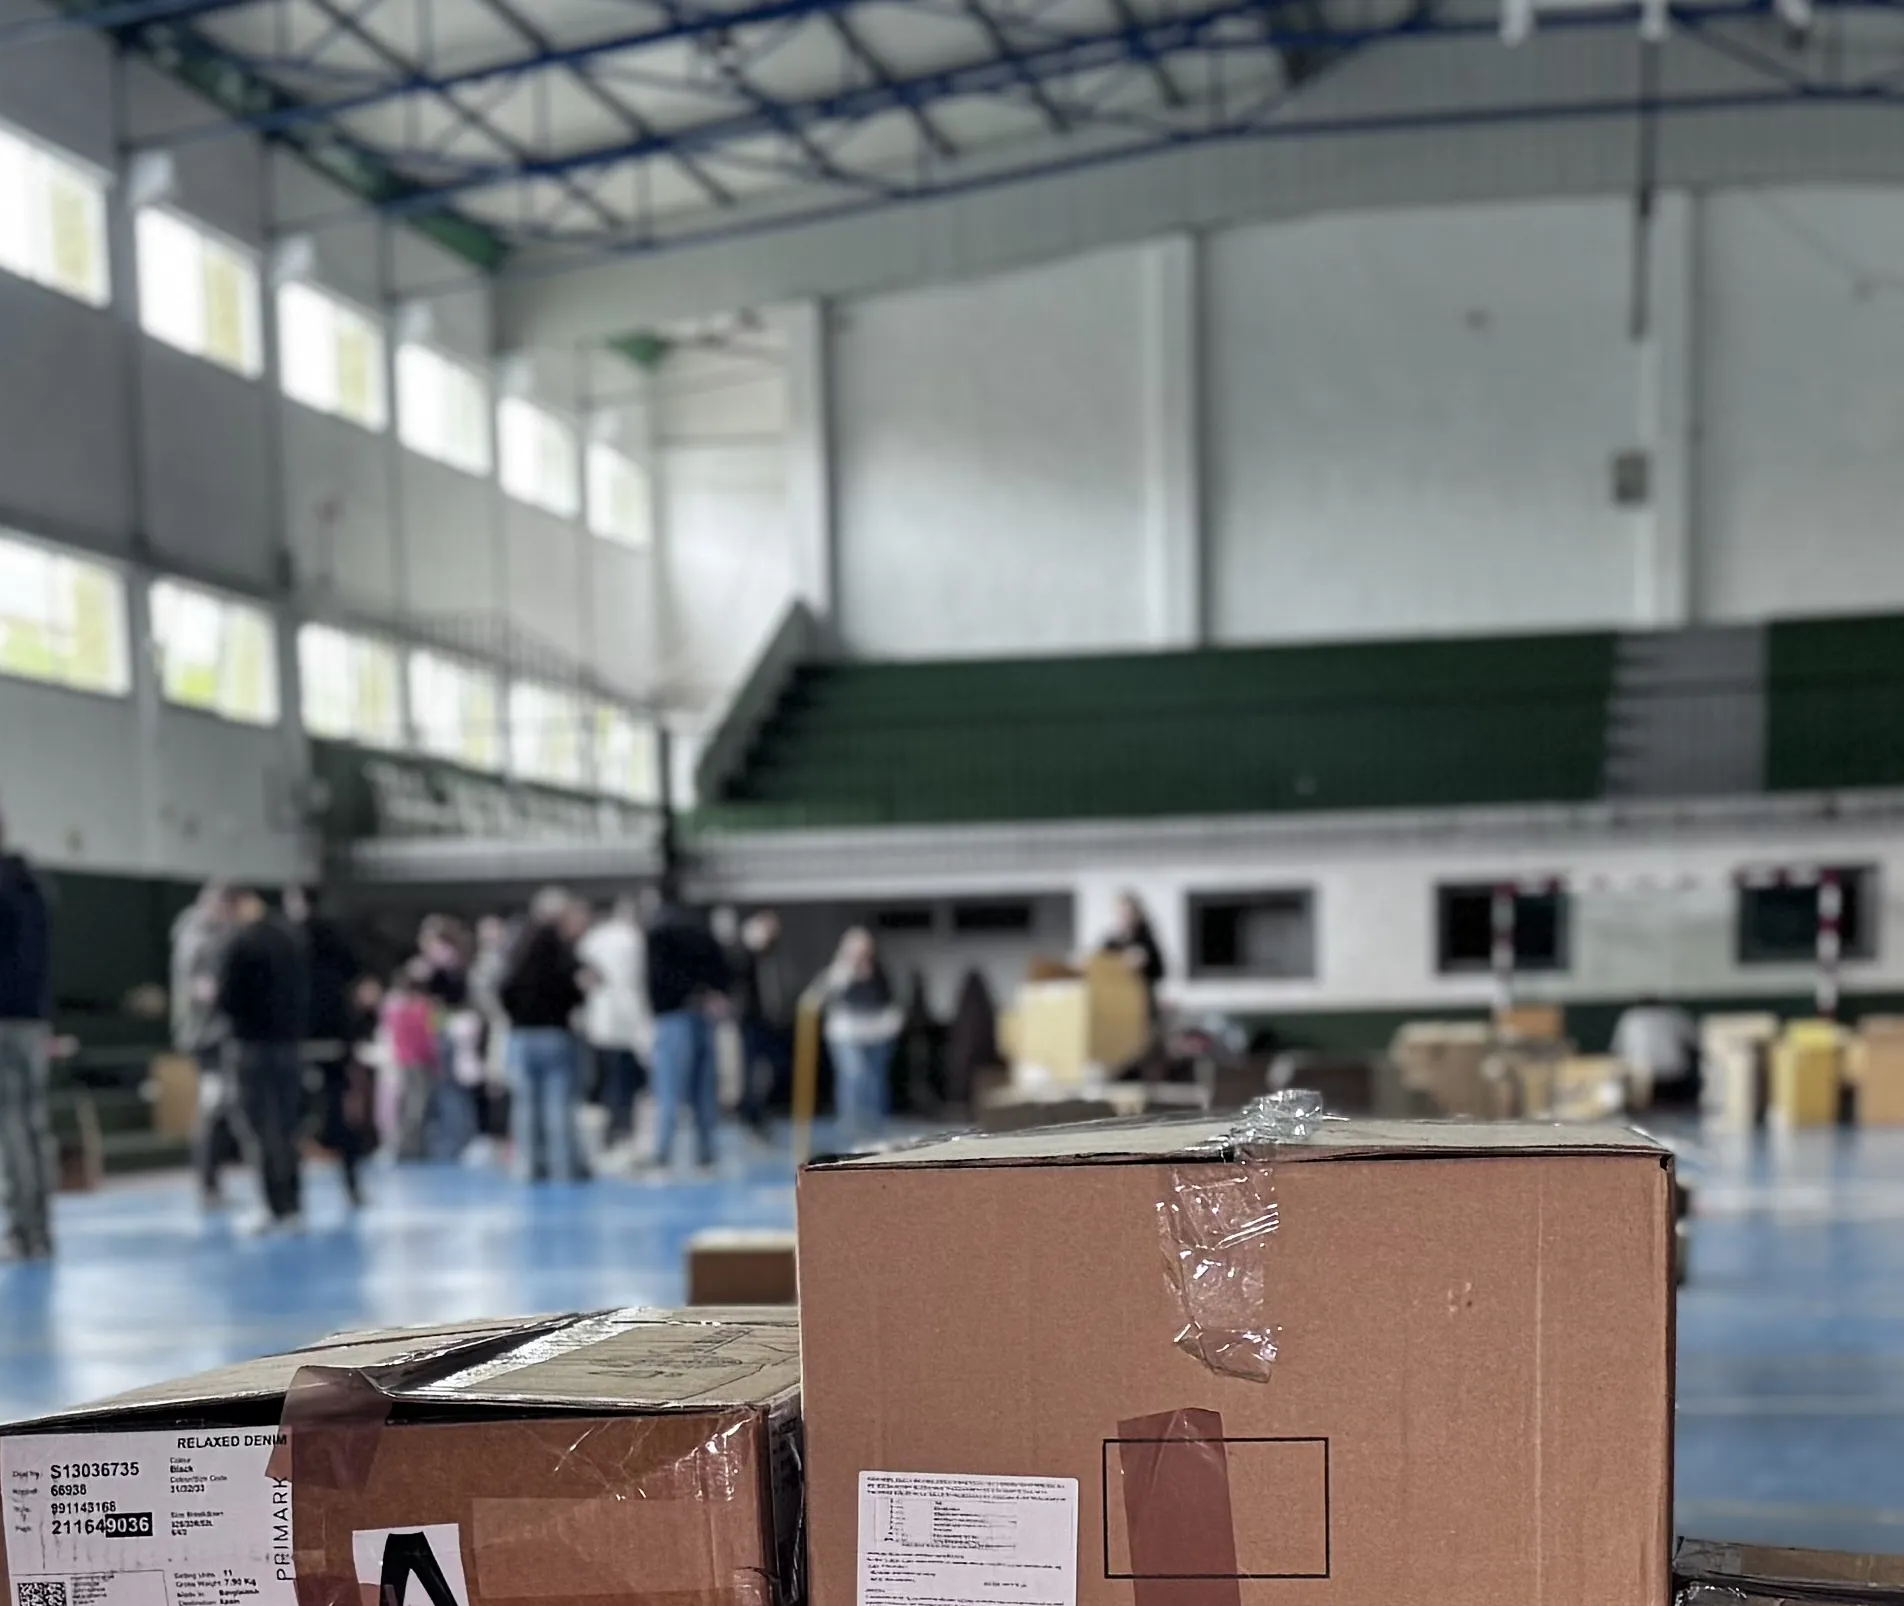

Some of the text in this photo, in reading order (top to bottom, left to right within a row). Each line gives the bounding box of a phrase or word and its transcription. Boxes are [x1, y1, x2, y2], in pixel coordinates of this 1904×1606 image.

[177, 1434, 287, 1449] RELAXED DENIM
[50, 1461, 140, 1479] S13036735
[50, 1484, 87, 1496] 66938
[51, 1500, 116, 1515] 991143168
[51, 1517, 150, 1534] 211649036
[272, 1476, 296, 1580] PRIMARK
